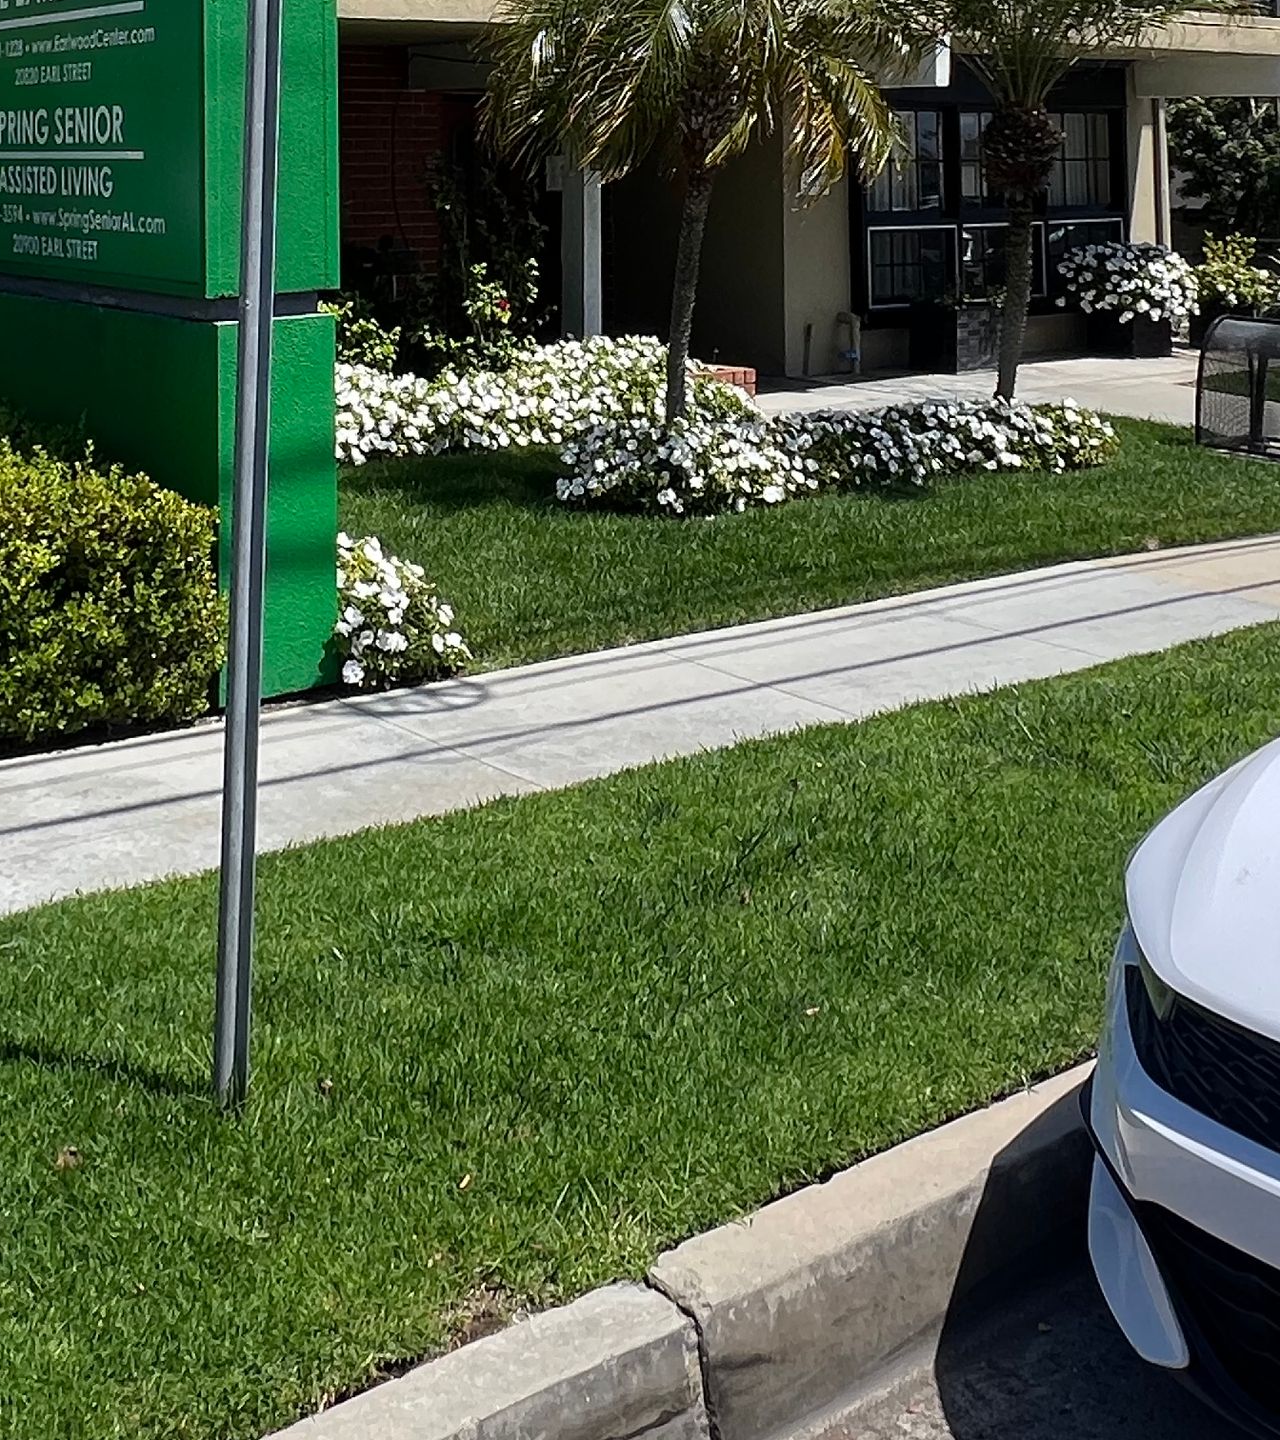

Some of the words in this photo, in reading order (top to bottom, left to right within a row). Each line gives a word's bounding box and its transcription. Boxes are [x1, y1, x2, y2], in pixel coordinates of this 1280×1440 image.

[31, 27, 155, 54] www.EarlwoodCenter.com
[40, 64, 61, 83] EARL
[63, 62, 92, 82] STREET
[54, 105, 124, 144] SENIOR
[61, 166, 114, 198] LIVING
[32, 207, 166, 234] www.SpringSeniorAL.com
[41, 236, 64, 257] EARL
[66, 238, 98, 260] STREET
